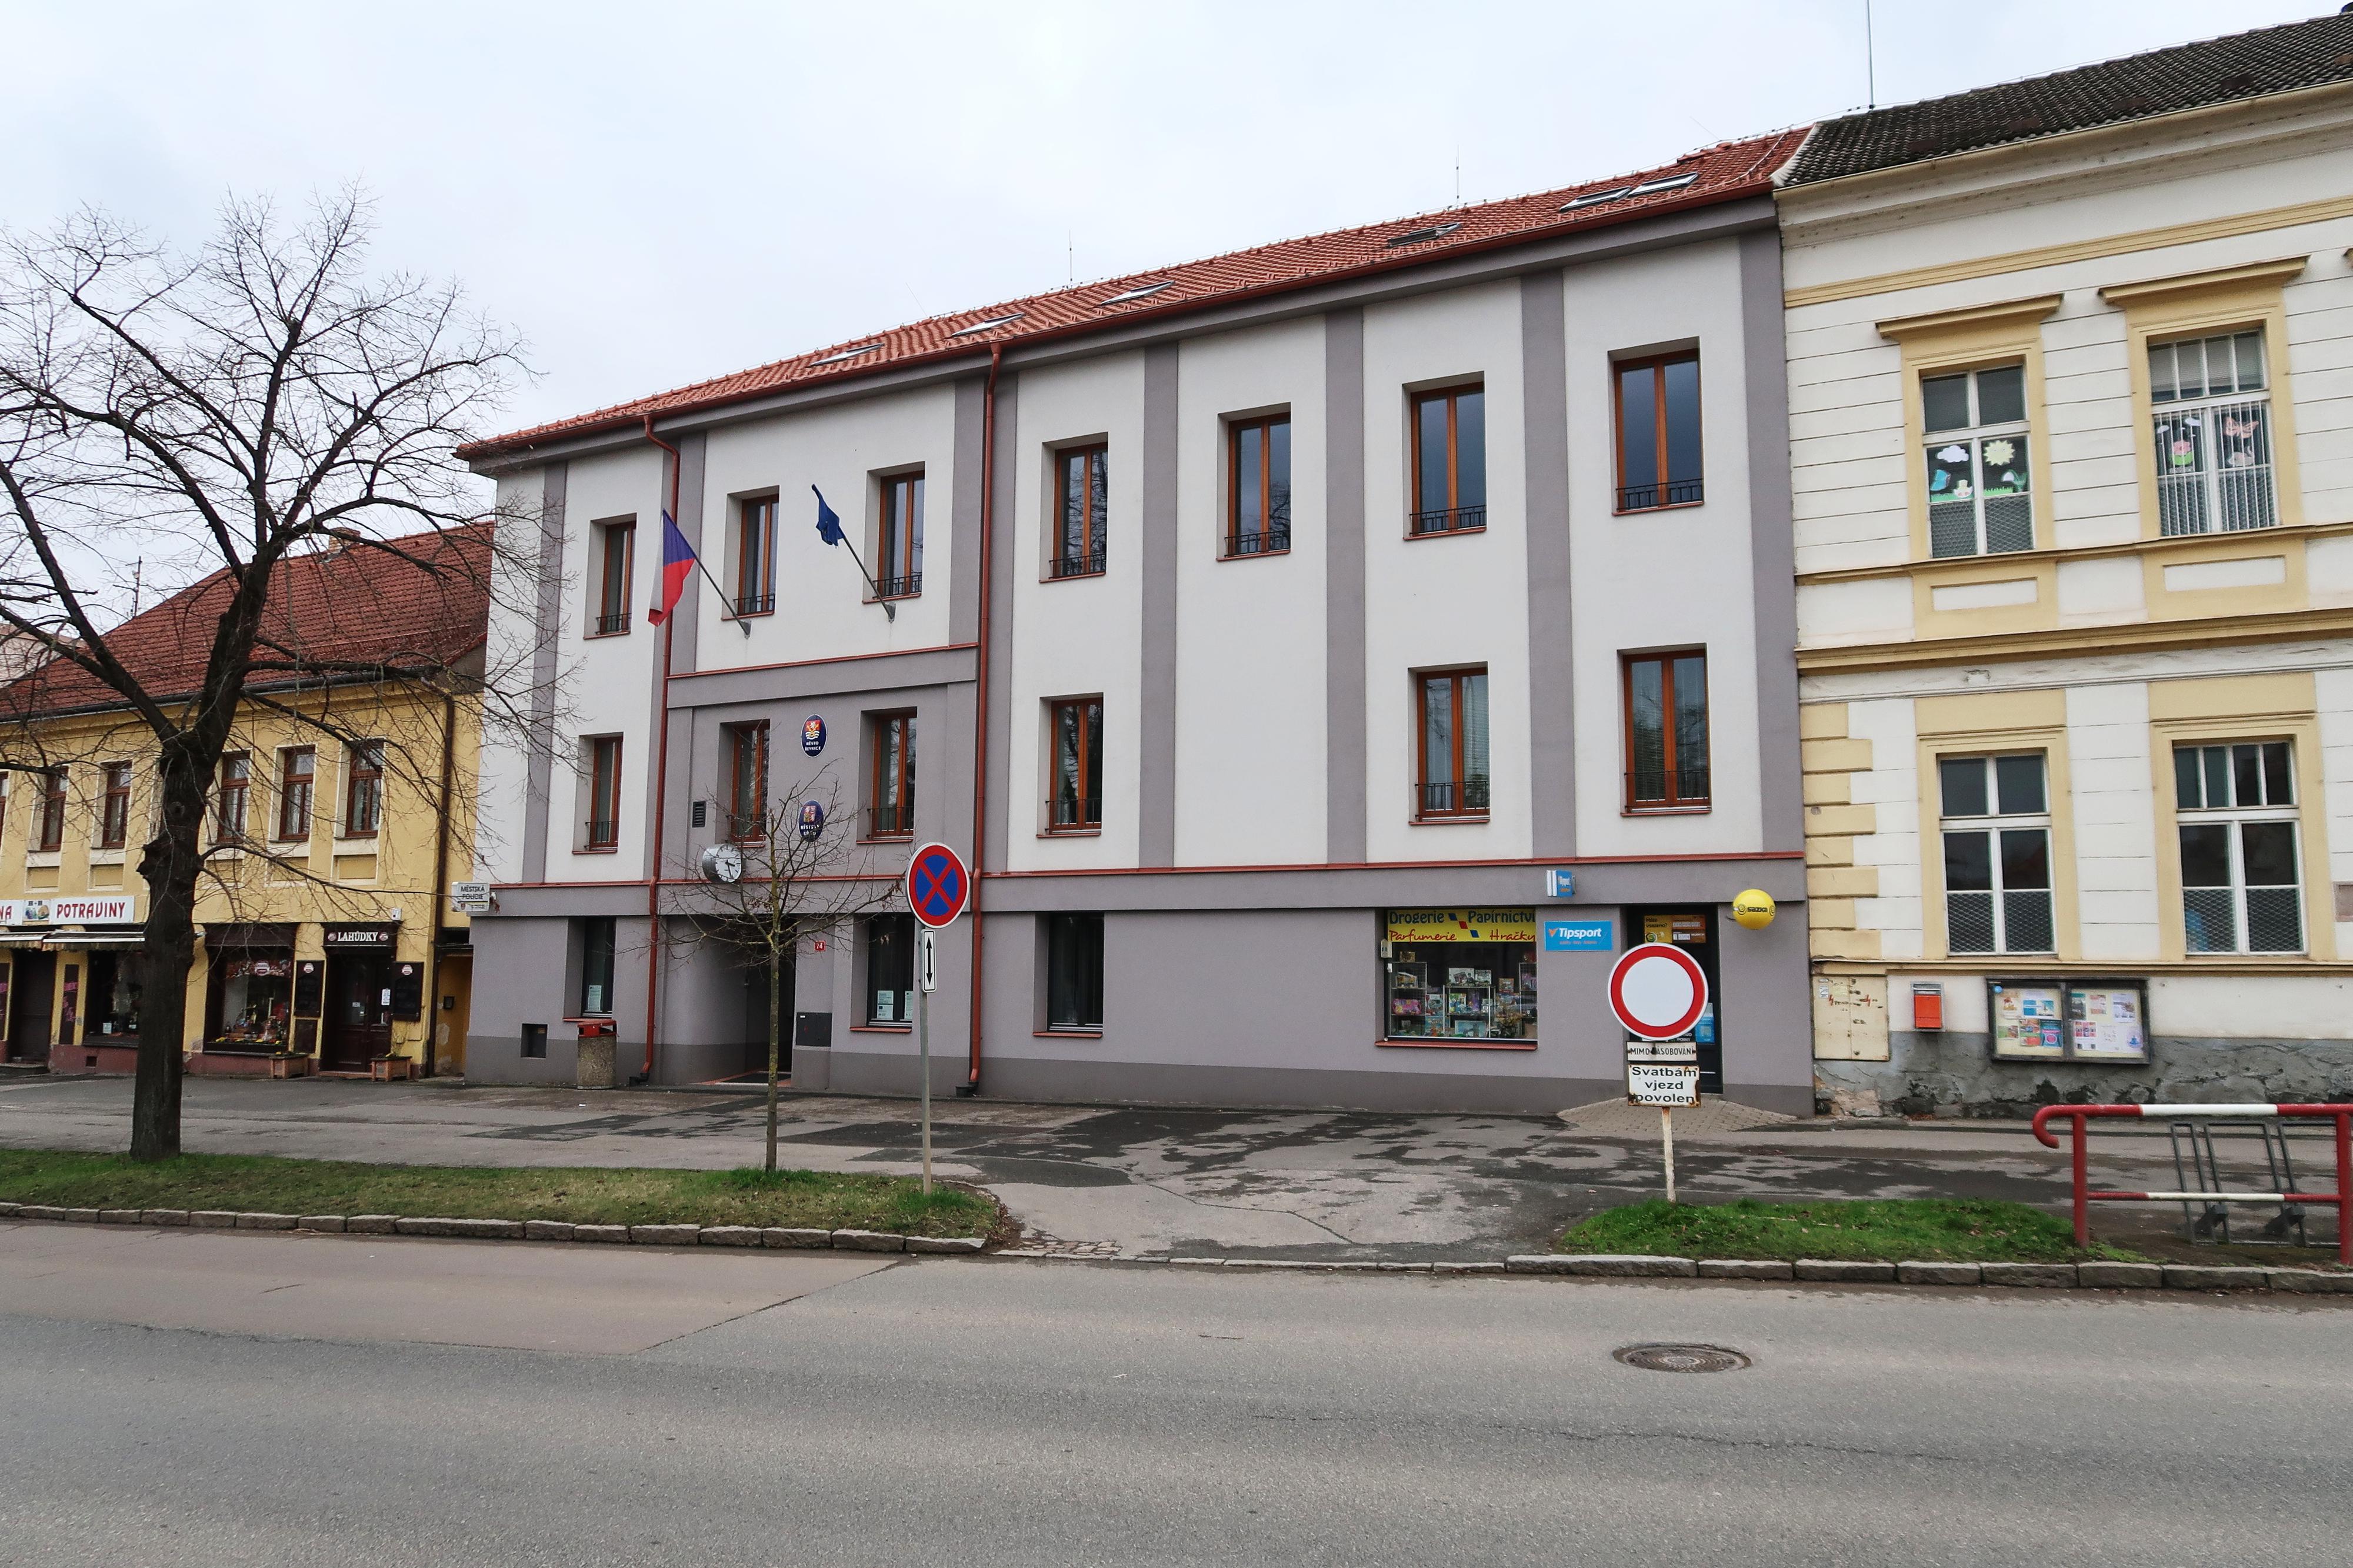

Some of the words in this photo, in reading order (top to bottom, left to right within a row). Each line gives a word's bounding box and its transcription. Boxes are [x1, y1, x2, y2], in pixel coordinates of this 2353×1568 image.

[56, 902, 125, 919] POTRAVINY
[1389, 910, 1445, 924] Drogerie
[337, 930, 378, 942] LAHŮDKY
[1389, 929, 1457, 943] Parfumerie
[1489, 929, 1535, 942] Hračky
[1559, 928, 1602, 939] Tipsport
[1651, 1046, 1694, 1055] ÁSOBOVÁNÍ
[1632, 1066, 1697, 1077] Svatbám
[1645, 1080, 1684, 1091] vjezd
[1635, 1094, 1694, 1103] povolen
